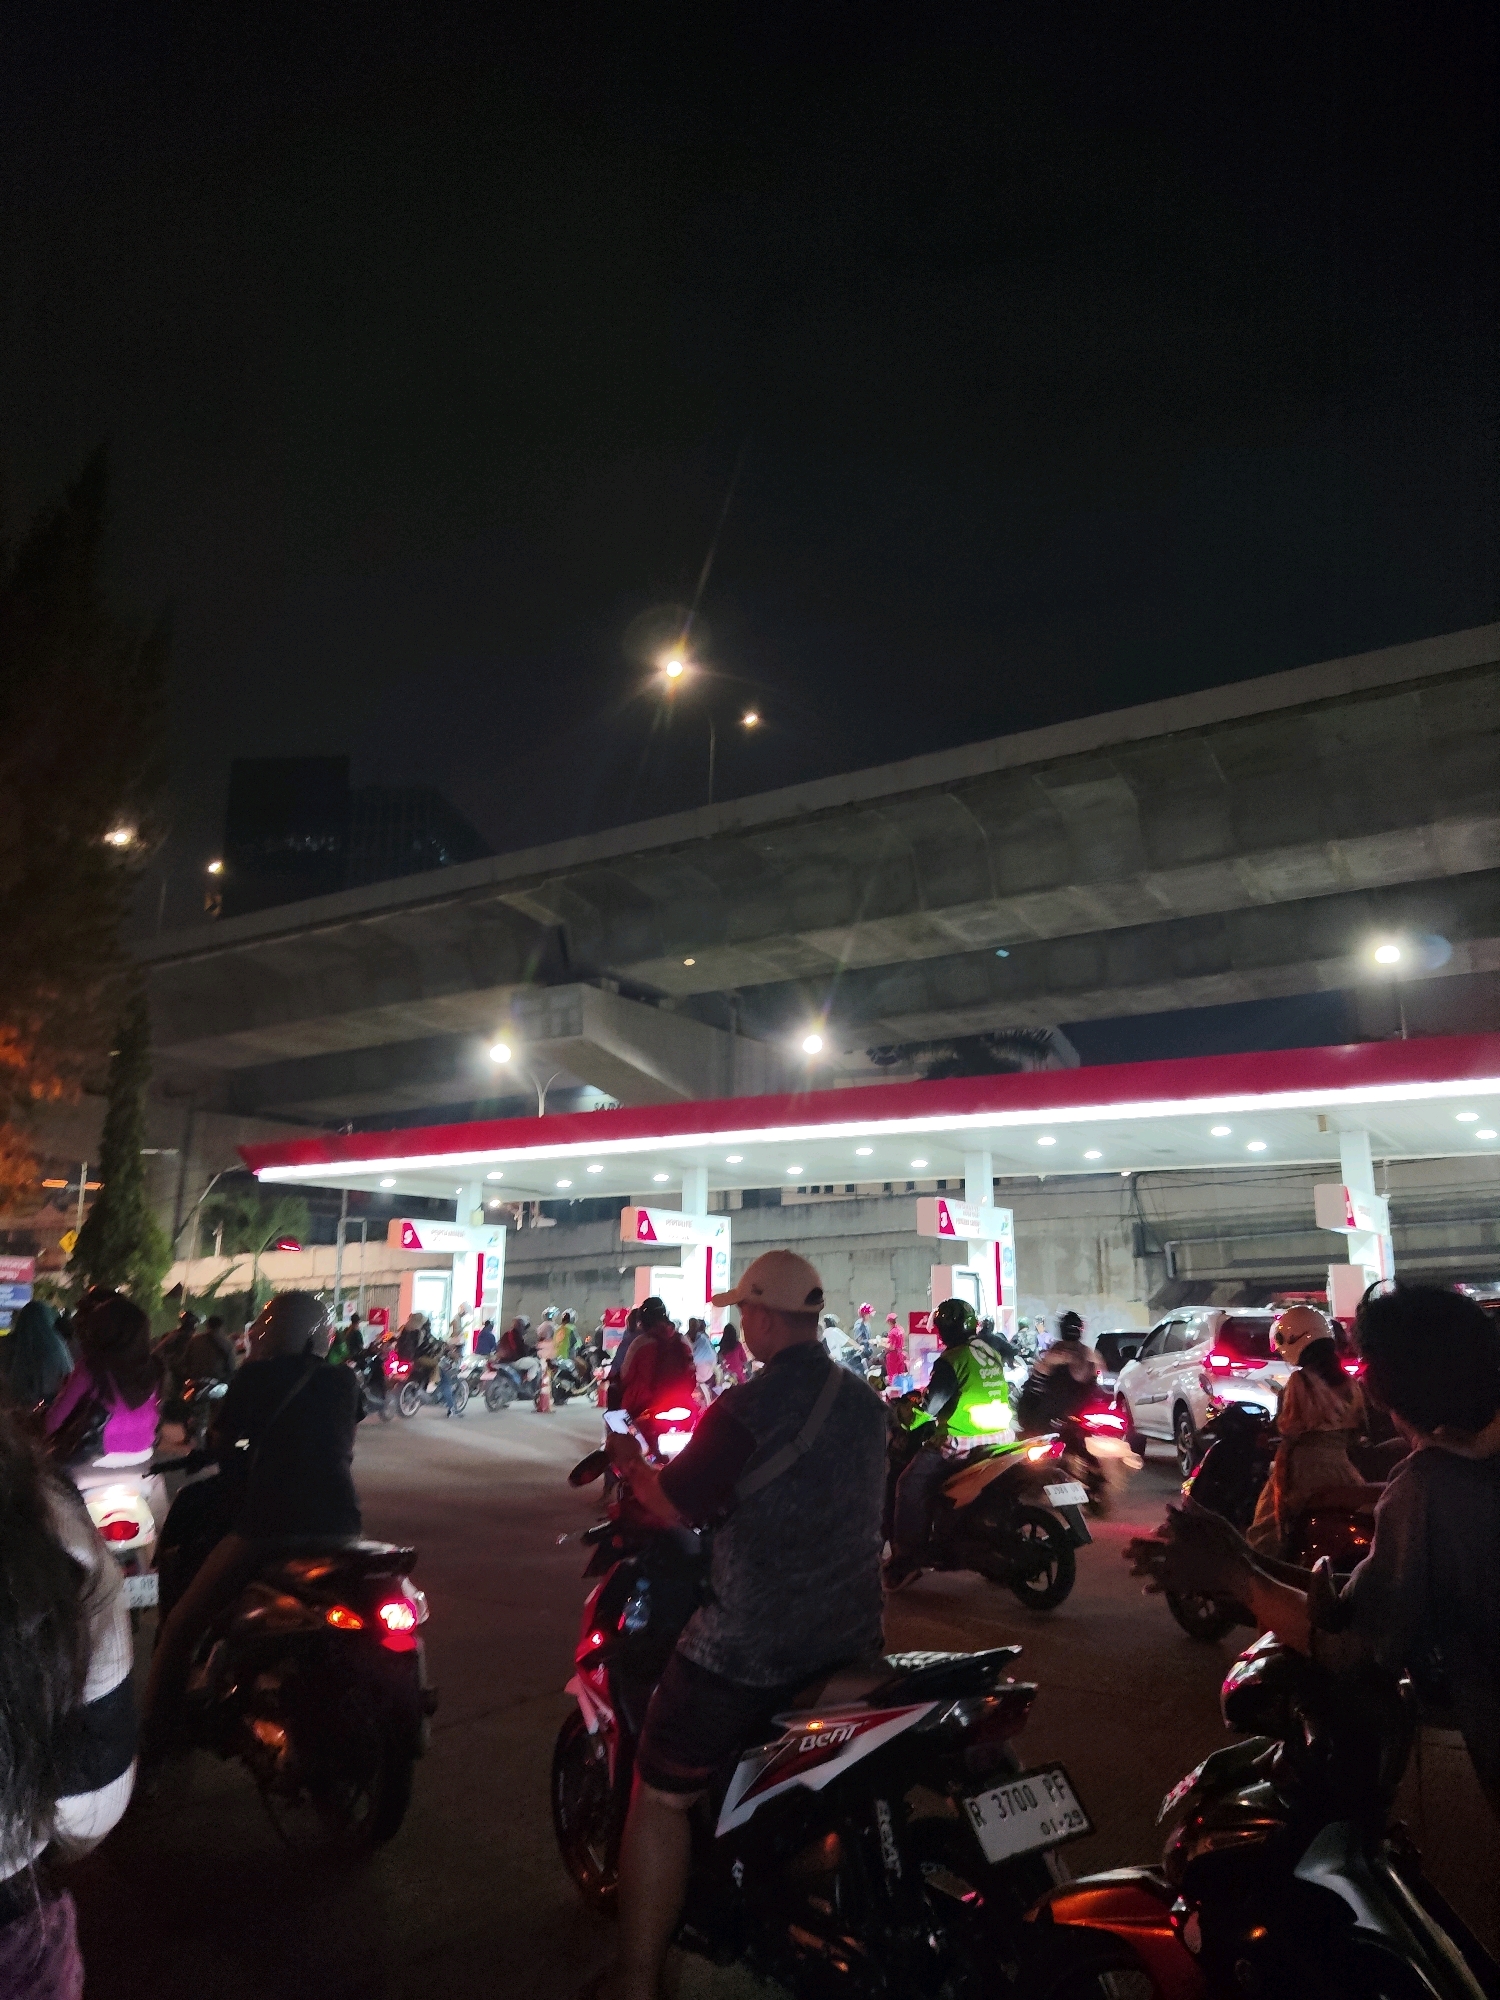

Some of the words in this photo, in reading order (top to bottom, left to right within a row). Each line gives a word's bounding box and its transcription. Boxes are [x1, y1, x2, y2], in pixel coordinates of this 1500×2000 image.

[639, 1219, 649, 1236] 4
[940, 1211, 949, 1228] 3
[990, 1784, 1039, 1820] 3700
